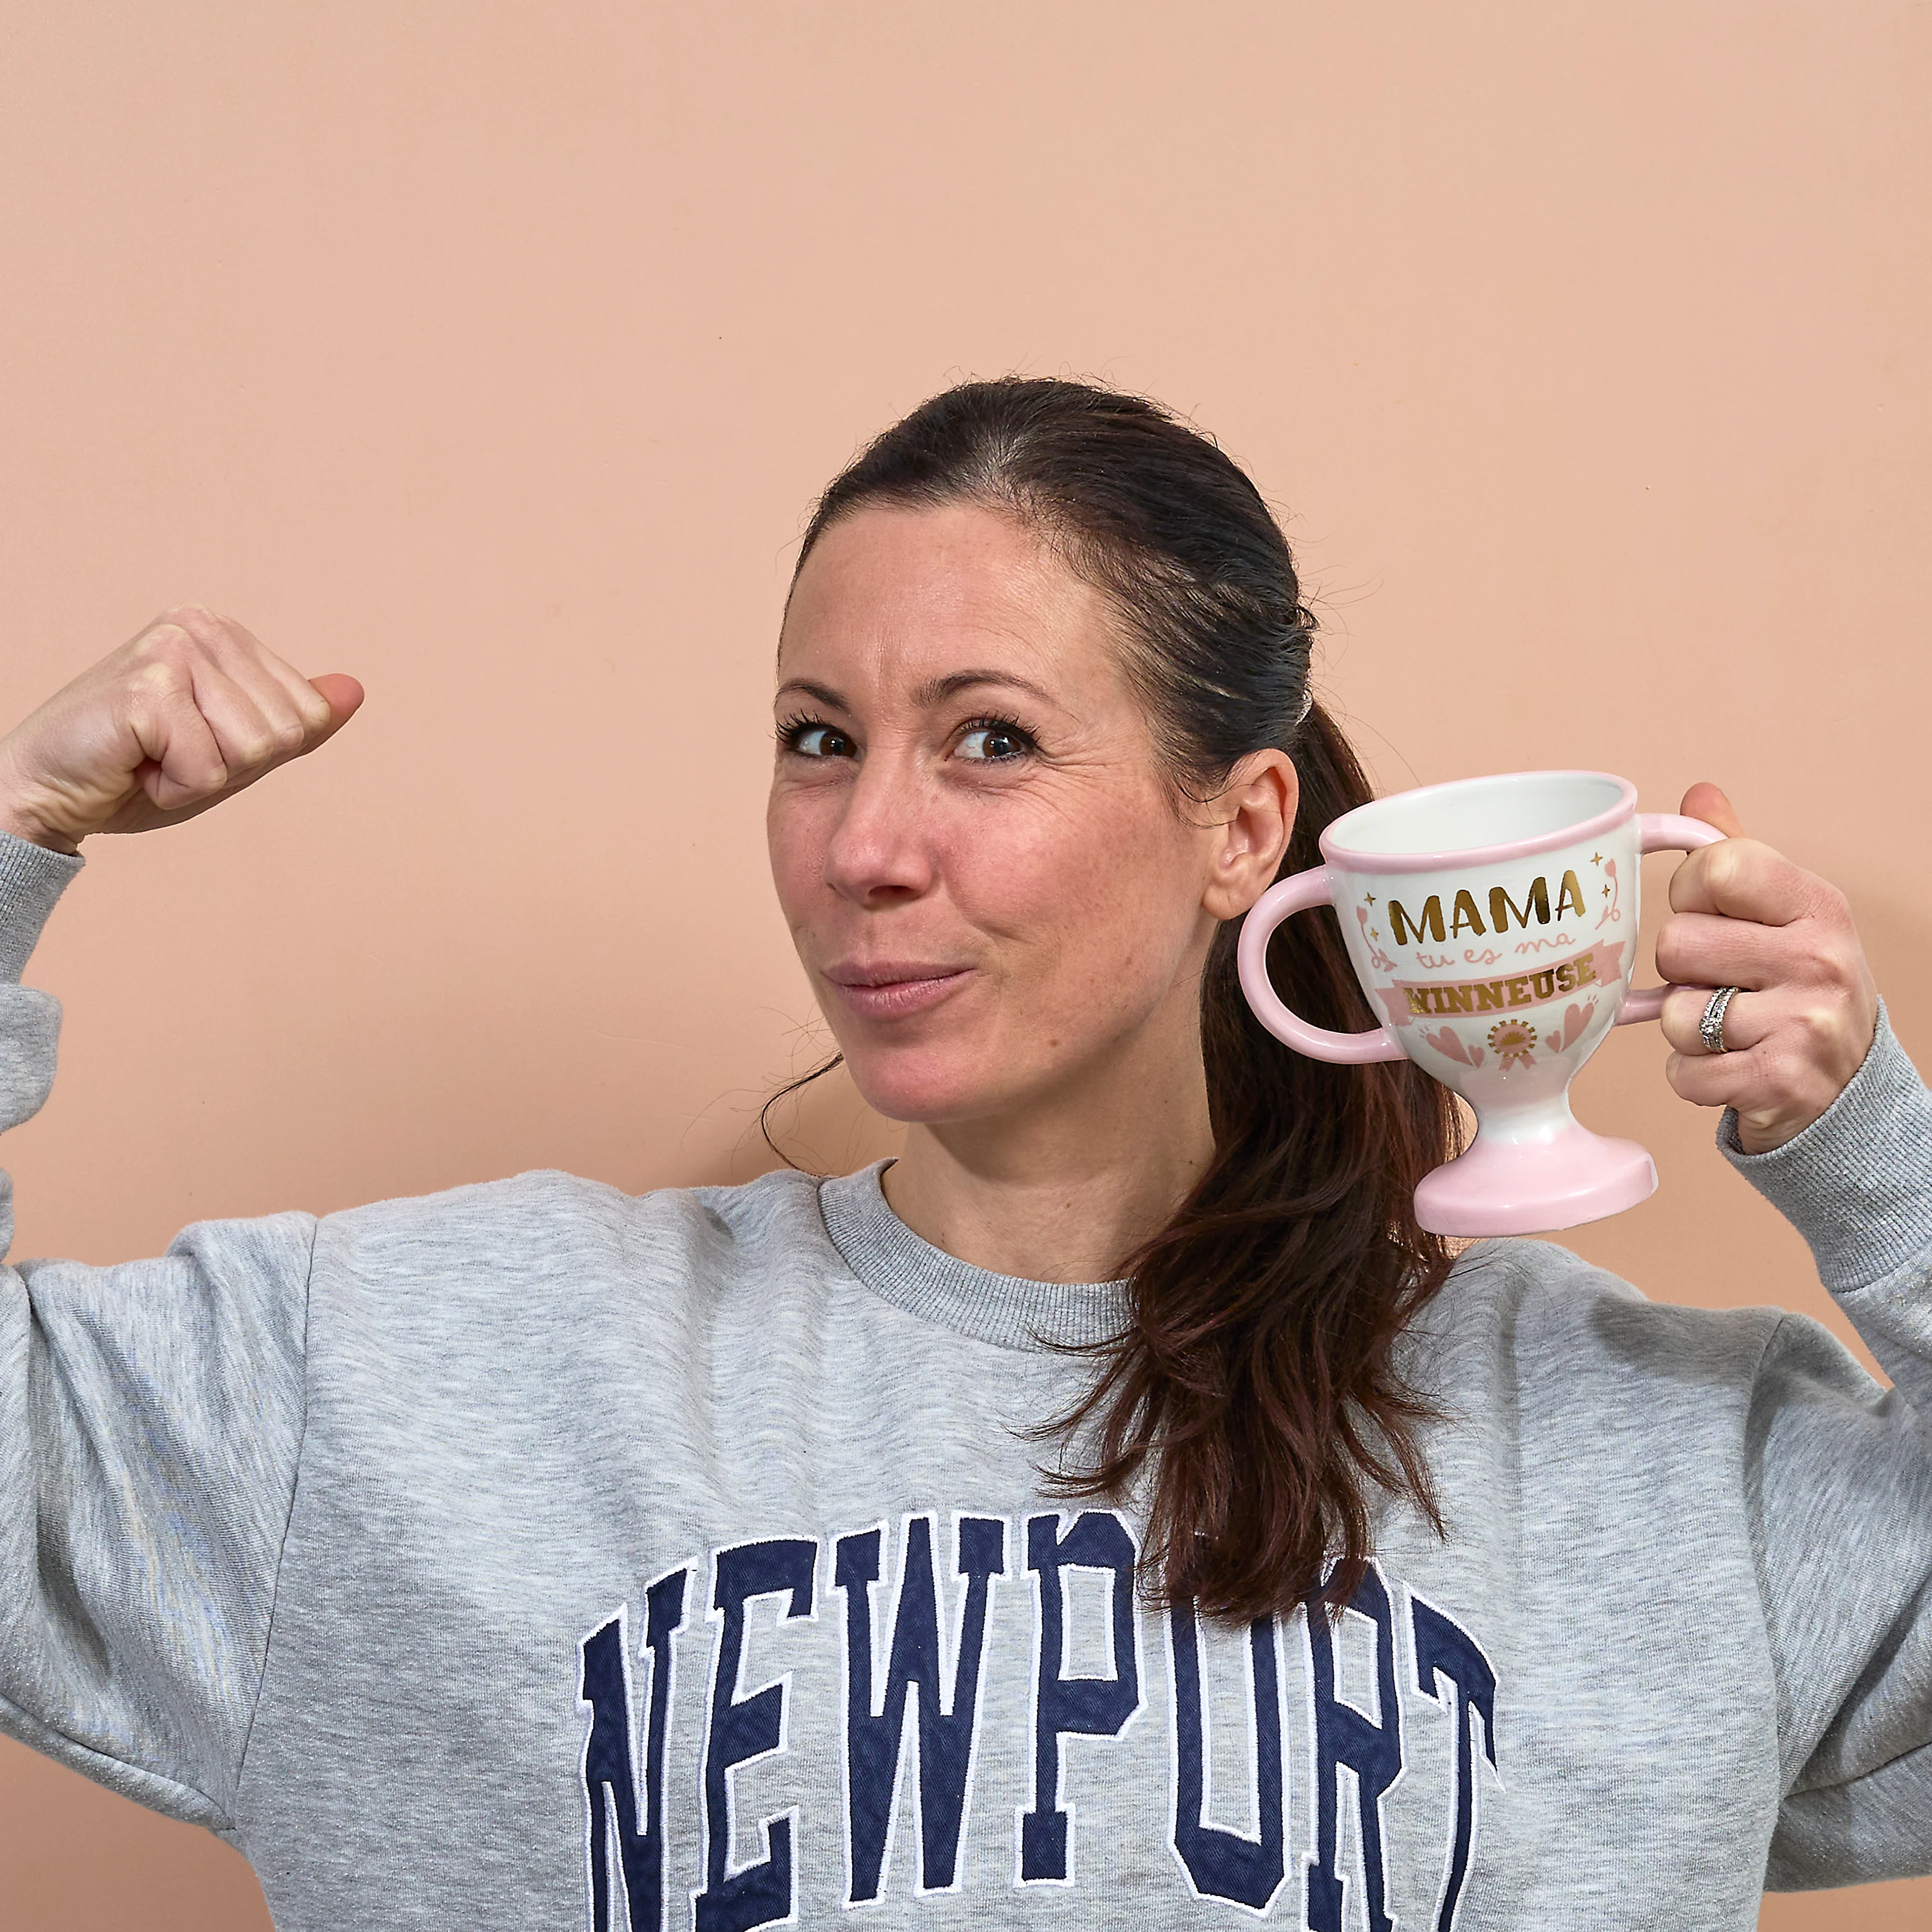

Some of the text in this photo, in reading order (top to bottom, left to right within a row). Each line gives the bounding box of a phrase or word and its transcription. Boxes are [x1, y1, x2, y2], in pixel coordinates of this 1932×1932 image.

[1388, 870, 1586, 945] MAMA
[1416, 933, 1575, 969] tu es ma
[578, 1508, 1506, 1932] NEWPORT
